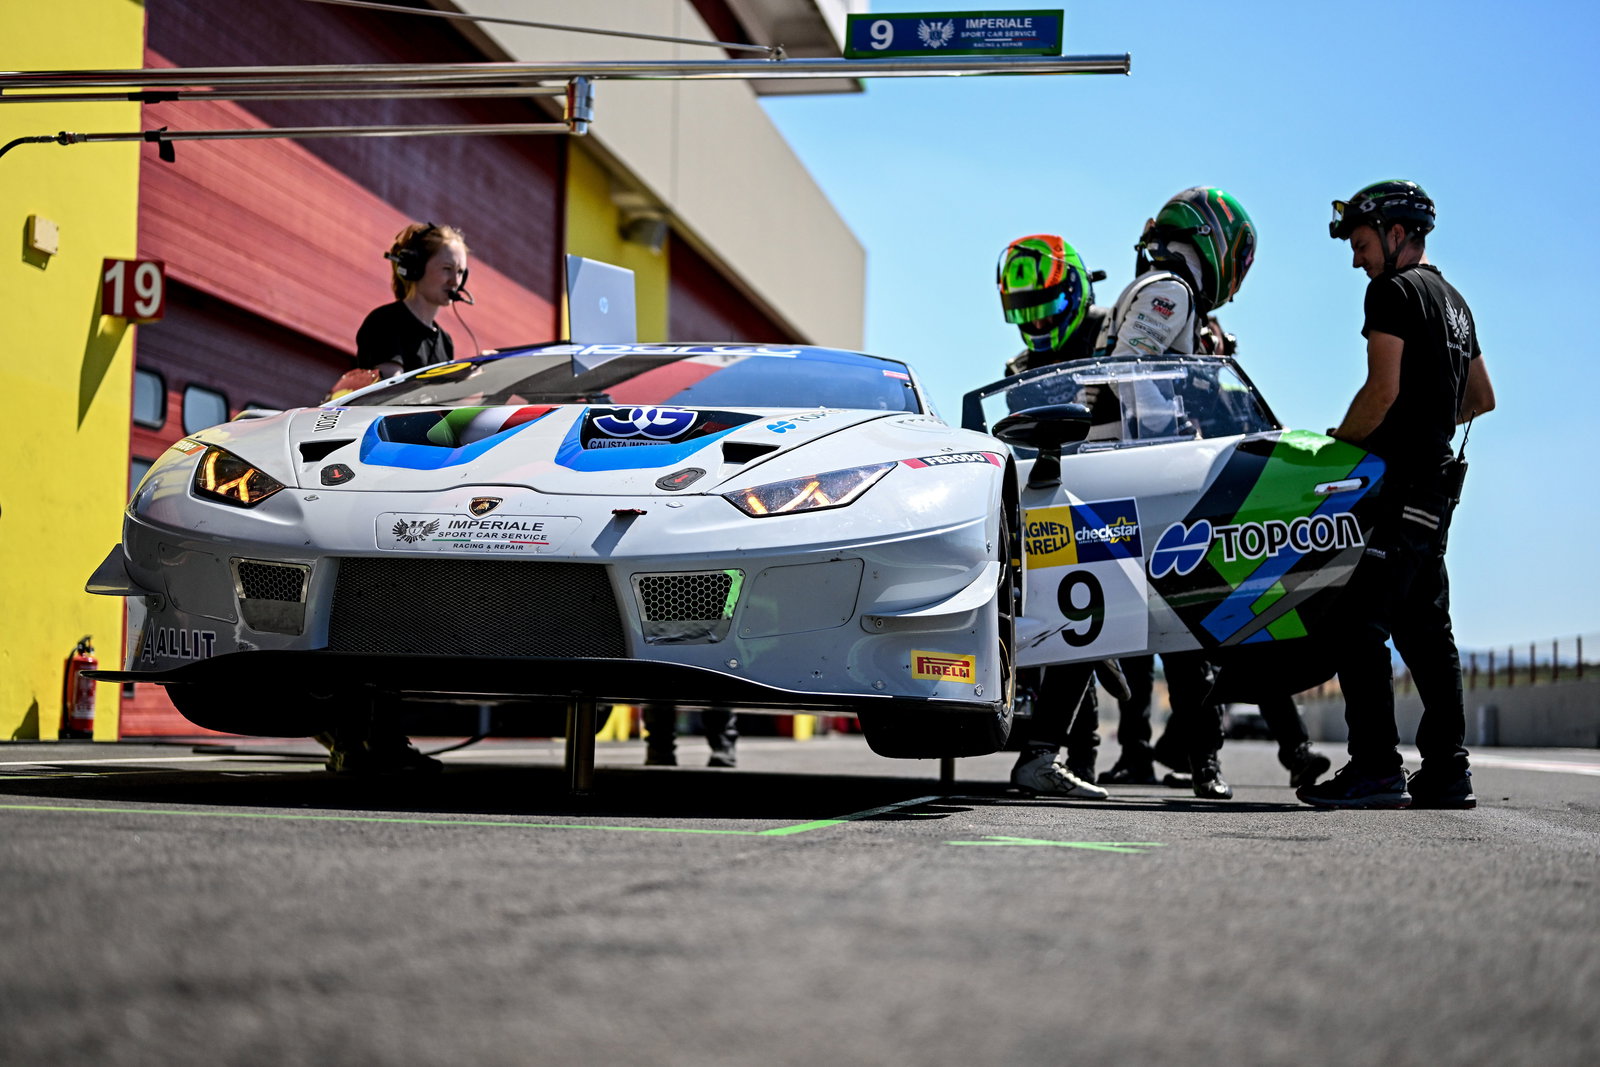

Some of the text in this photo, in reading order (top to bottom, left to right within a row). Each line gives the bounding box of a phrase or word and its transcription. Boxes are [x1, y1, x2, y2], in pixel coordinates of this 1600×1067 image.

[965, 17, 1033, 29] IMPERIALE
[869, 19, 895, 50] 9
[104, 260, 162, 317] 19
[922, 452, 986, 466] FERODO
[448, 520, 545, 532] IMPERIALE
[1075, 524, 1138, 541] checkstar
[501, 533, 548, 541] SERVICE
[1214, 512, 1364, 562] TOPCON
[1057, 570, 1105, 647] 9
[916, 656, 971, 678] PIRELLI
